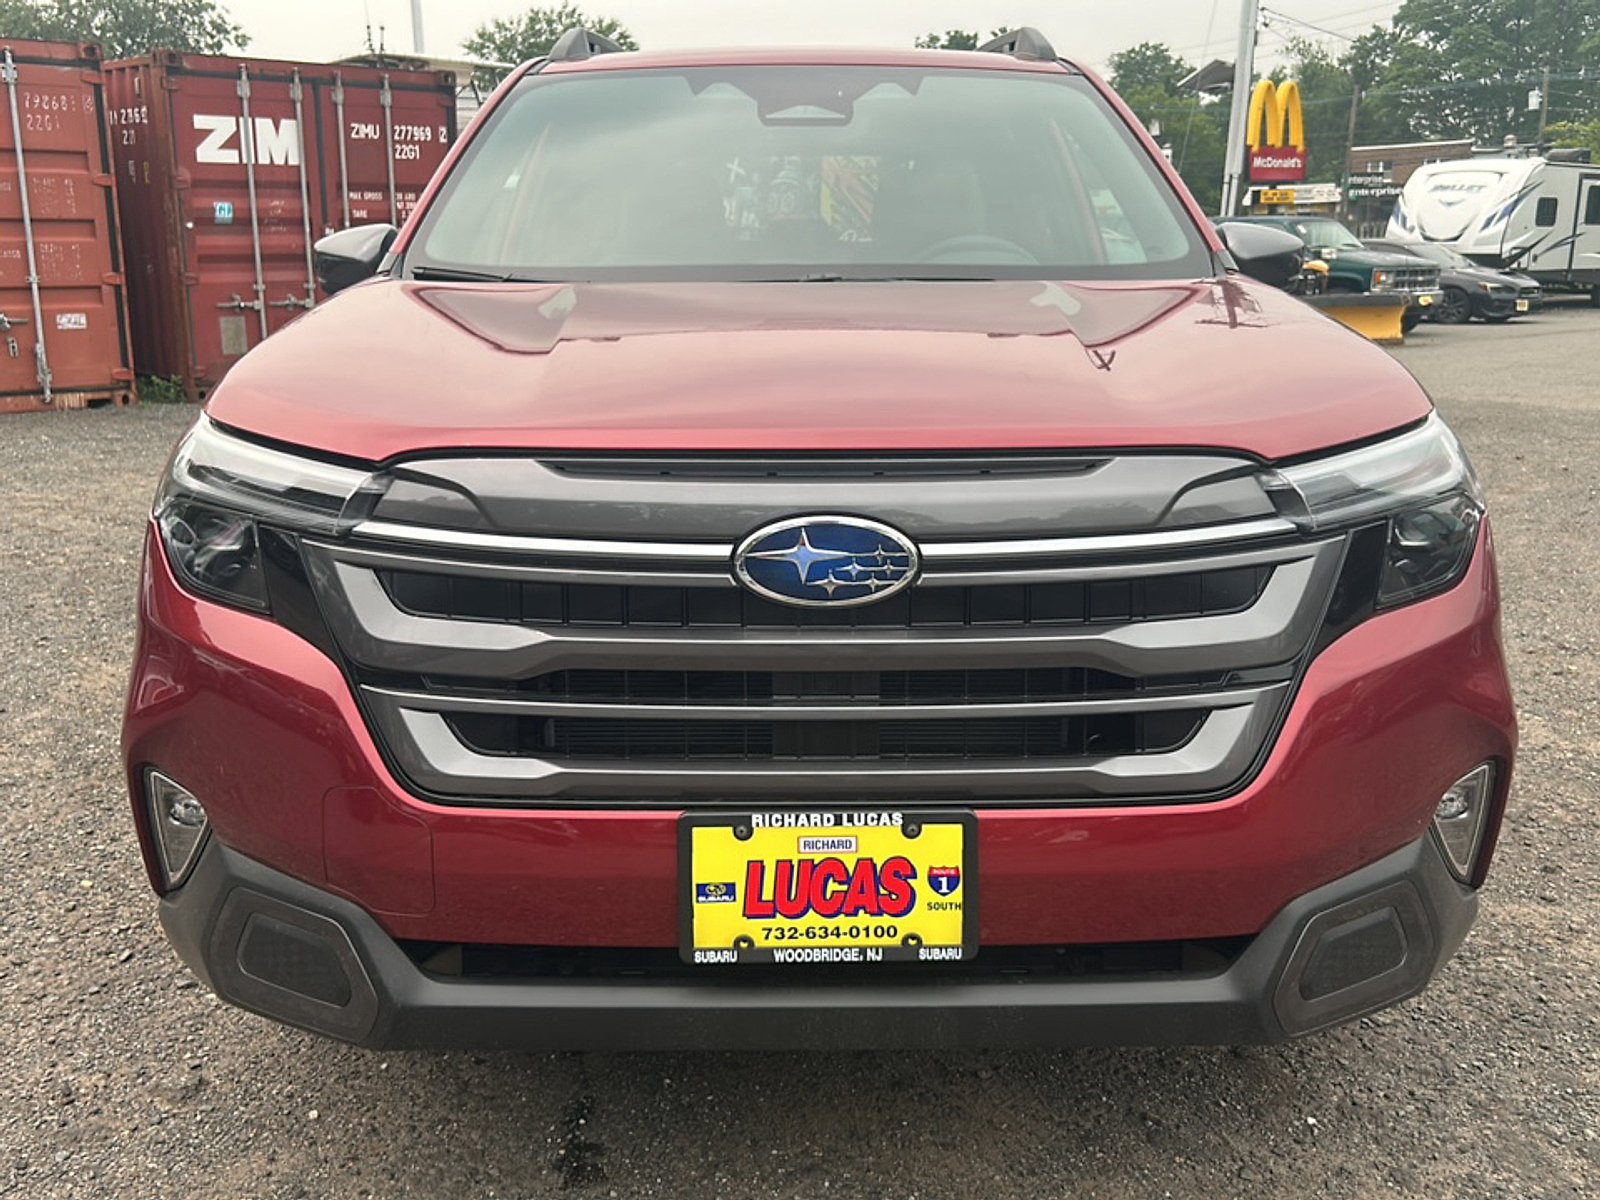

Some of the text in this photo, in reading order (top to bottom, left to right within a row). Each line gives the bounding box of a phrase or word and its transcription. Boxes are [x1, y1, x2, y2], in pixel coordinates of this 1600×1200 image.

[193, 114, 301, 166] ZIM
[350, 123, 448, 143] ZIMU 277969 2
[395, 144, 420, 160] 22G1
[1253, 157, 1302, 168] McDonald's
[751, 812, 904, 828] RICHARD LUCAS
[802, 839, 853, 851] RICHARD
[743, 856, 918, 919] LUCAS
[938, 876, 950, 893] 1
[927, 902, 962, 911] SOUTH
[761, 925, 898, 940] 732-634-0100
[694, 950, 738, 963] SUBARU
[866, 948, 883, 961] NJ
[918, 947, 962, 960] SUBARU
